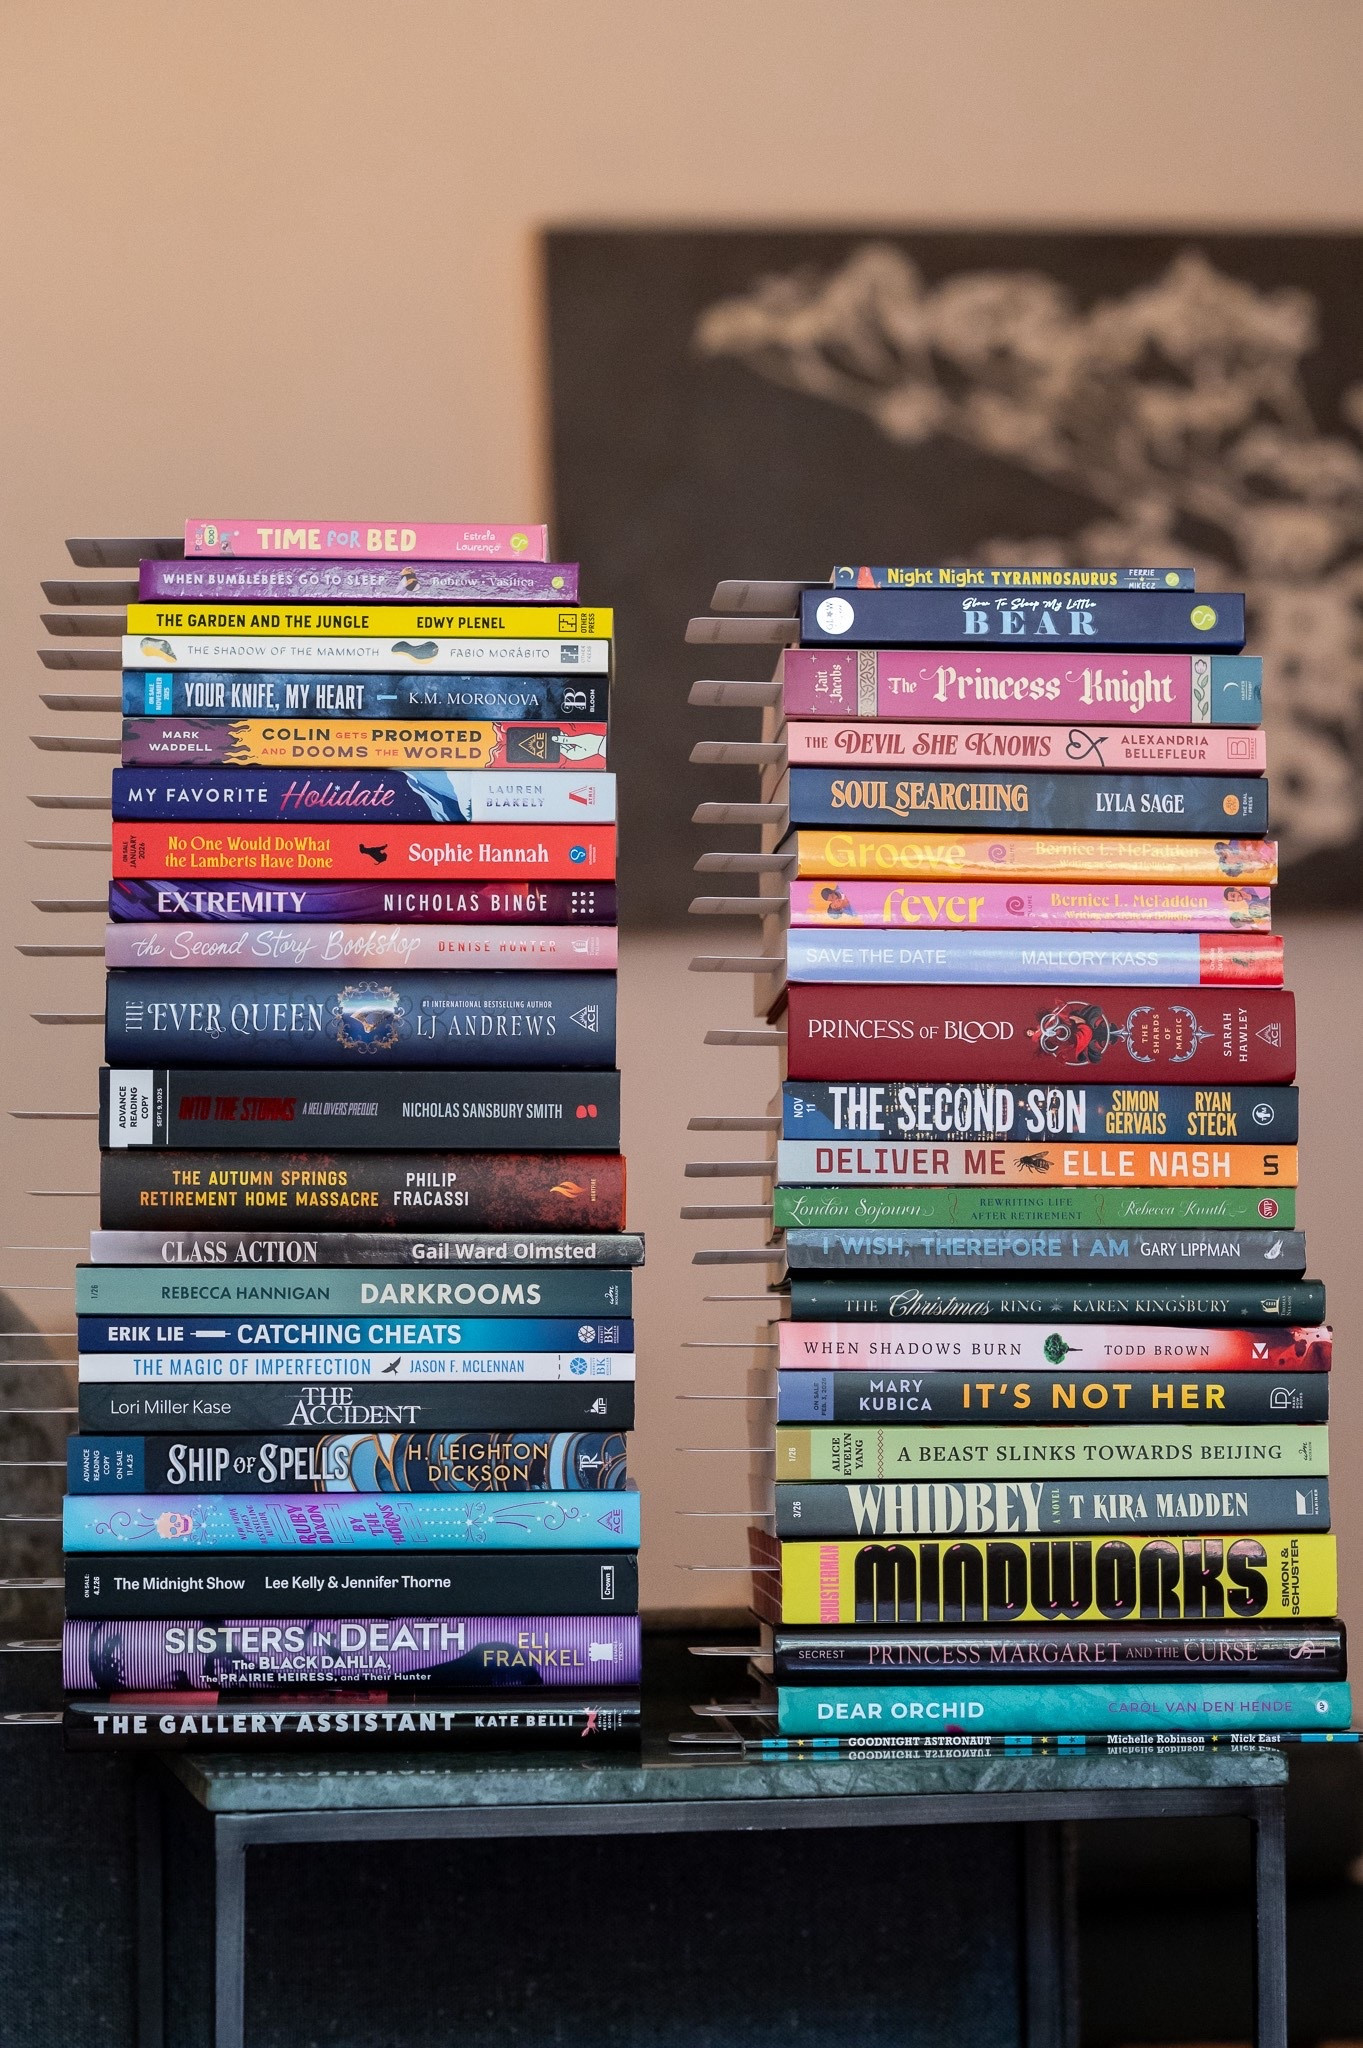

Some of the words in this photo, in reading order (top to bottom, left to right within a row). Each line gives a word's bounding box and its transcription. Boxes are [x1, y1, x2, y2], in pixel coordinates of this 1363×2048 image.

[163, 573, 202, 585] WHEN
[208, 573, 293, 586] BUMBLEBEES
[299, 574, 319, 586] GO
[325, 574, 341, 586] TO
[346, 575, 386, 587] SLEEP
[888, 568, 933, 587] Night
[939, 568, 984, 587] Night
[992, 571, 1117, 586] TYRANNOSAURUS
[156, 613, 182, 627] THE
[188, 613, 245, 628] GARDEN
[251, 614, 280, 628] AND
[286, 614, 311, 628] THE
[316, 615, 369, 629] JUNGLE
[188, 645, 208, 655] THE
[214, 645, 266, 656] SHADOW
[271, 646, 286, 656] OF
[291, 646, 312, 656] THE
[317, 647, 379, 657] MAMMOTH
[450, 648, 485, 659] FABIO
[489, 645, 550, 659] MORÁBITO
[185, 683, 224, 709] YOUR
[231, 683, 279, 711] KNIFE,
[286, 684, 309, 710] MY
[317, 684, 364, 710] HEART
[887, 676, 917, 695] The
[920, 665, 1061, 703] Princess
[1065, 667, 1176, 713] Knight
[163, 731, 199, 739] MARK
[262, 728, 330, 741] COLIN
[336, 732, 368, 740] GETS
[372, 729, 482, 742] PROMOTED
[1121, 735, 1209, 746] ALEXANDRIA
[149, 743, 212, 752] WADDELL
[1125, 748, 1206, 760] BELLEFLEUR
[129, 788, 156, 802] MY
[167, 787, 268, 802] FAVORITE
[281, 781, 395, 811] Holidate
[489, 785, 542, 795] LAUREN
[1096, 792, 1136, 813] LYLA
[1141, 794, 1184, 814] SAGE
[409, 842, 473, 866] Sophie
[479, 843, 549, 863] Hannah
[825, 835, 966, 869] Groove
[158, 892, 306, 912] EXTREMITY
[384, 894, 480, 912] NICHOLAS
[491, 894, 548, 912] BINGE
[883, 888, 984, 923] fever
[438, 940, 490, 952] DENISE
[499, 940, 557, 952] HUNTER
[1022, 950, 1108, 966] MALLORY
[1112, 952, 1158, 966] KASS
[588, 1004, 596, 1032] ACE
[417, 1015, 437, 1039] LJ
[449, 1015, 556, 1037] ANDREWS
[808, 1019, 914, 1040] PRINCESS
[920, 1026, 939, 1039] OF
[945, 1020, 1014, 1044] BLOOD
[1223, 1013, 1232, 1057] SARAH
[1239, 1008, 1248, 1062] HAWLEY
[119, 1086, 127, 1129] ADVANCE
[130, 1086, 138, 1128] READING
[794, 1097, 803, 1118] NOV
[1112, 1090, 1159, 1112] SIMON
[402, 1102, 459, 1118] NICHOLAS
[463, 1103, 524, 1119] SANSBURY
[526, 1103, 563, 1119] SMITH
[1106, 1112, 1166, 1135] GERVAIS
[816, 1147, 949, 1175] DELIVER
[965, 1150, 1006, 1176] ME
[173, 1171, 200, 1186] THE
[208, 1171, 273, 1186] AUTUMN
[281, 1171, 347, 1186] SPRINGS
[980, 1198, 1044, 1207] REWRITING
[1048, 1198, 1072, 1207] LIFE
[161, 1241, 227, 1263] CLASS
[234, 1241, 317, 1263] ACTION
[1140, 1242, 1177, 1257] GARY
[1181, 1242, 1240, 1257] LIPPMAN
[161, 1286, 231, 1300] REBECCA
[236, 1286, 330, 1300] HANNIGAN
[361, 1283, 541, 1305] DARKROOMS
[1073, 1300, 1129, 1312] KAREN
[1135, 1300, 1229, 1312] KINGSBURY
[108, 1326, 150, 1341] ERIK
[157, 1326, 184, 1341] LIE
[604, 1326, 613, 1343] BK
[1104, 1344, 1146, 1356] TODD
[1154, 1344, 1210, 1356] BROWN
[134, 1359, 162, 1375] THE
[170, 1359, 222, 1375] MAGIC
[229, 1359, 248, 1375] OF
[255, 1359, 371, 1375] IMPERFECTION
[870, 1379, 923, 1393] MARY
[110, 1400, 139, 1414] Lori
[145, 1400, 189, 1414] Miller
[193, 1400, 231, 1414] Kase
[860, 1398, 932, 1411] KUBICA
[408, 1444, 429, 1461] H.
[438, 1443, 548, 1461] LEIGHTON
[832, 1437, 840, 1472] ALICE
[843, 1432, 852, 1476] EVELYN
[897, 1447, 912, 1461] A
[918, 1446, 989, 1461] BEAST
[996, 1446, 1076, 1461] SLINKS
[1083, 1445, 1193, 1460] TOWARDS
[1201, 1445, 1282, 1460] BEIJING
[428, 1465, 528, 1482] DICKSON
[793, 1501, 801, 1518] 3/26
[1069, 1495, 1084, 1519] T
[1093, 1493, 1148, 1523] KIRA
[1157, 1492, 1248, 1518] MADDEN
[1281, 1547, 1289, 1559] &
[114, 1578, 139, 1590] The
[143, 1577, 204, 1592] Midnight
[207, 1577, 245, 1590] Show
[854, 1538, 1268, 1622] MINDWORKS
[1281, 1562, 1289, 1607] SIMON
[1292, 1538, 1300, 1616] SCHUSTER
[518, 1632, 549, 1649] ELI
[483, 1650, 584, 1667] FRANKEL
[798, 1650, 845, 1659] SECREST
[868, 1644, 981, 1665] PRINCESS
[989, 1642, 1122, 1664] MARGARET
[1126, 1647, 1152, 1659] AND
[1155, 1646, 1179, 1658] THE
[1184, 1641, 1258, 1662] CURSE
[200, 1675, 217, 1683] The
[220, 1673, 274, 1682] PRAIRIE
[278, 1672, 338, 1683] HEIRESS,
[341, 1672, 359, 1682] and
[362, 1672, 390, 1681] Their
[394, 1672, 431, 1681] Hunter
[817, 1703, 882, 1720] DEAR
[891, 1702, 984, 1719] ORCHID
[1108, 1702, 1159, 1713] CAROL
[1165, 1702, 1197, 1713] VAN
[1203, 1701, 1235, 1712] DEN
[1240, 1701, 1292, 1712] HENDE
[475, 1715, 519, 1727] KATE
[526, 1715, 573, 1727] BELLI
[849, 1736, 920, 1747] GOODNIGHT
[924, 1735, 991, 1746] ASTRONAUT
